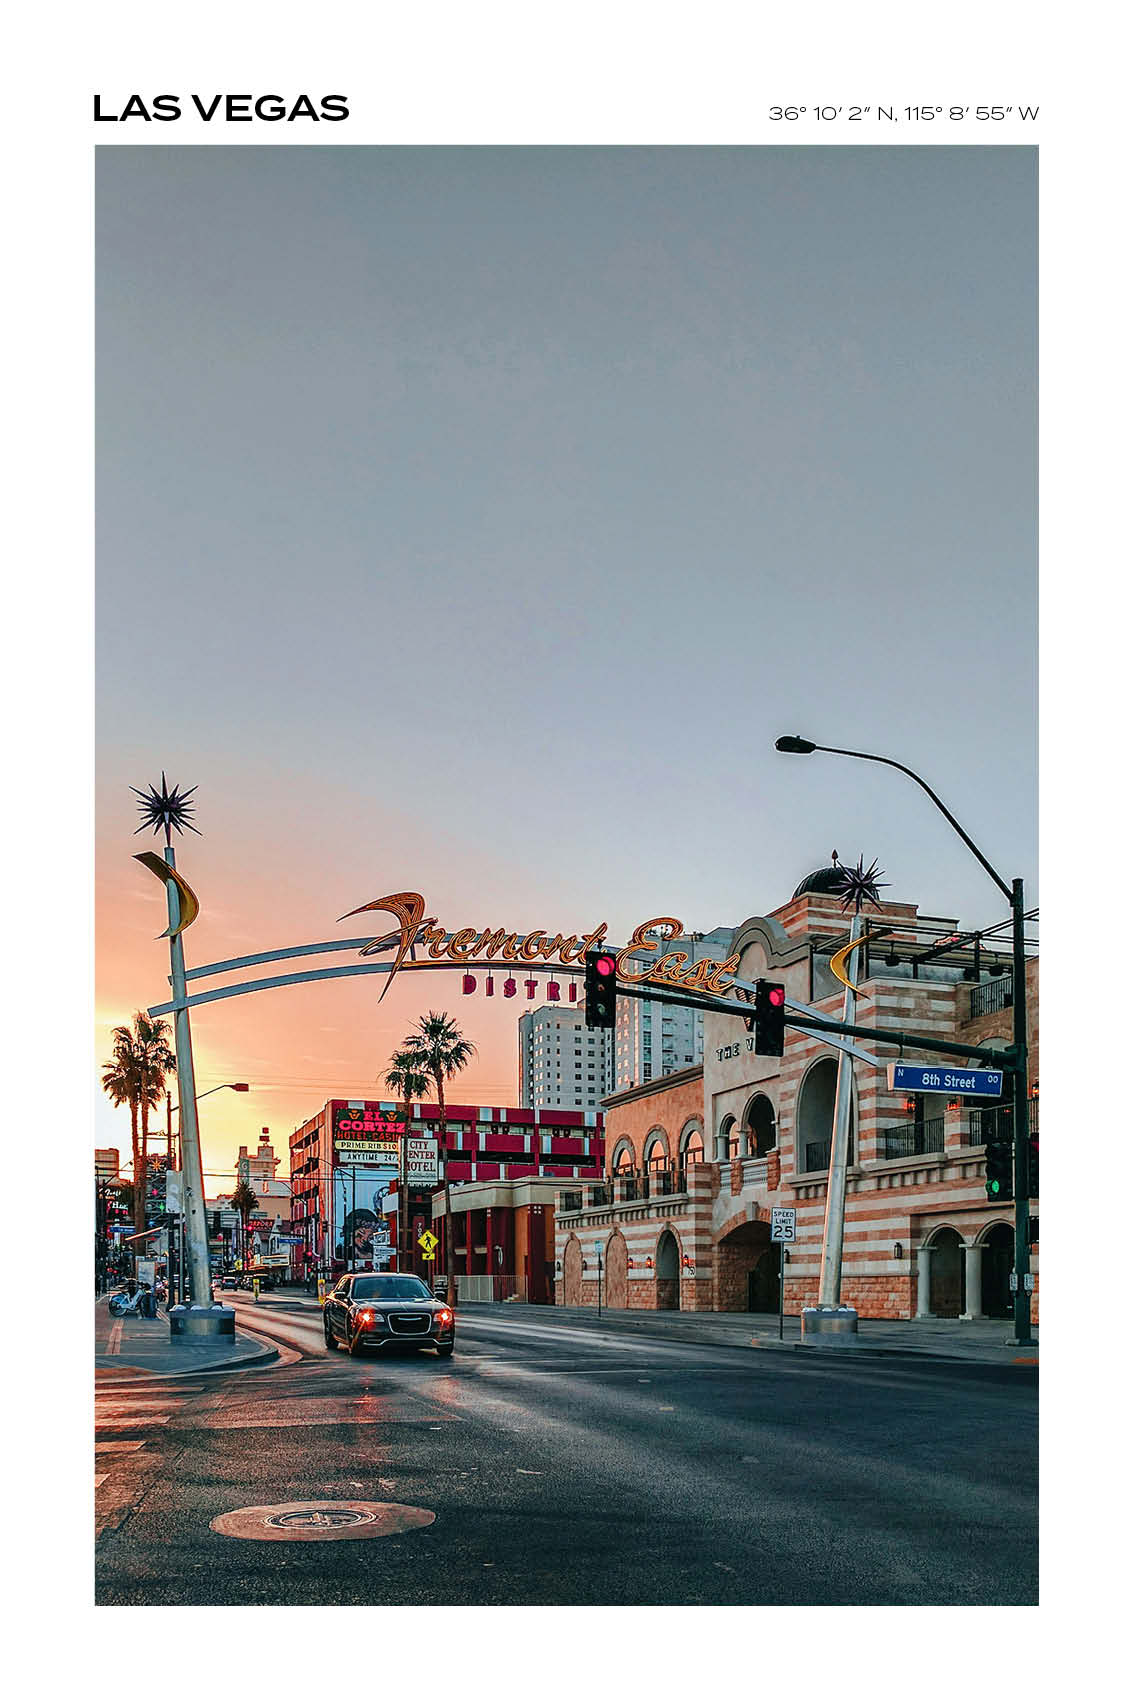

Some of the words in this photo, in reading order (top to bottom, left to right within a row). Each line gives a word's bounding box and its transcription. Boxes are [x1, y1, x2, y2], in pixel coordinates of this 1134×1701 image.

[336, 892, 608, 1004] Fremont
[615, 916, 741, 991] East
[462, 974, 580, 1003] DISTRI
[716, 1042, 740, 1061] THE
[898, 1068, 905, 1077] N
[921, 1072, 941, 1086] 8th
[944, 1074, 976, 1089] Street
[363, 1111, 385, 1121] EL
[338, 1120, 407, 1133] CORTEZ
[341, 1141, 366, 1149] PRIME
[368, 1142, 382, 1150] RIB
[410, 1141, 429, 1150] CITY
[347, 1152, 378, 1161] ANYTIME
[407, 1151, 436, 1160] ENTER
[773, 1210, 794, 1218] SPEED
[773, 1225, 793, 1239] 25
